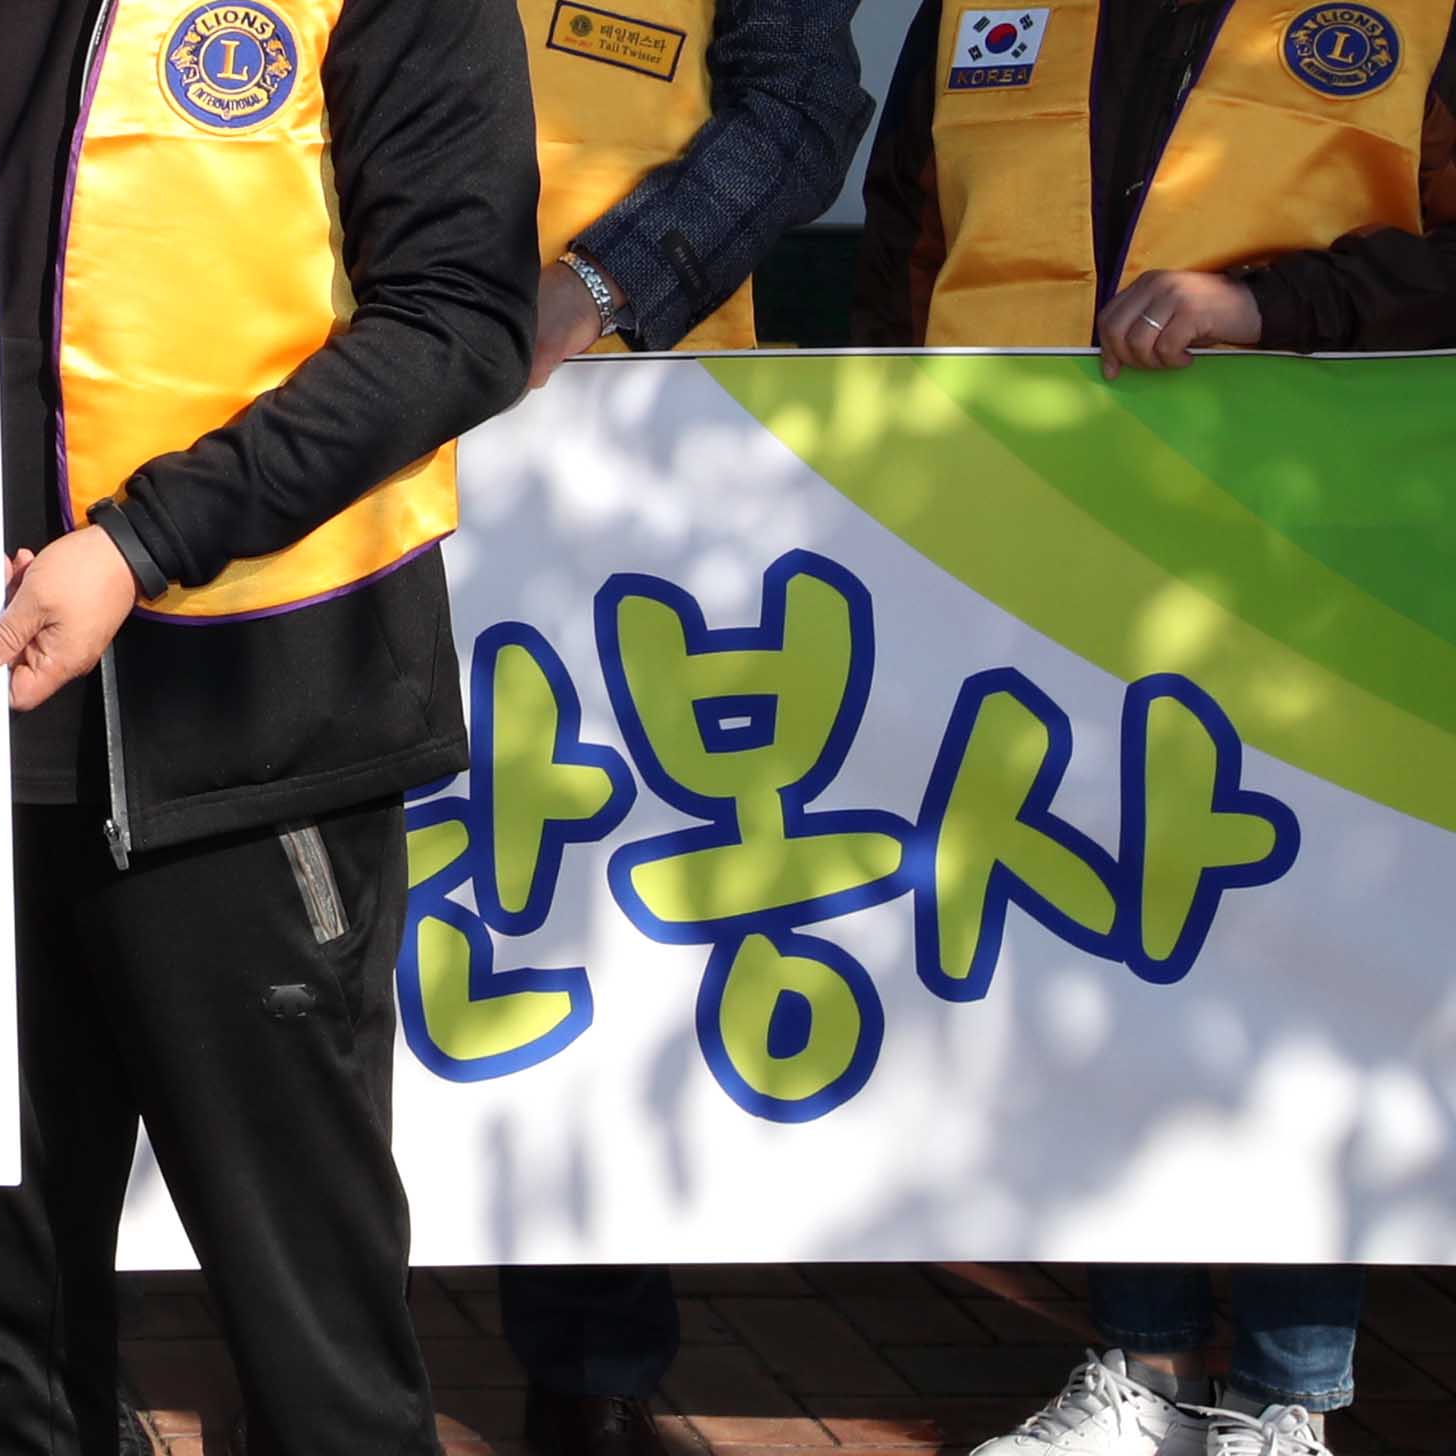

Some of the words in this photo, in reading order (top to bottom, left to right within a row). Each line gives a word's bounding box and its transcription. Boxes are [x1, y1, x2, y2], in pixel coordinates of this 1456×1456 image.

[201, 9, 271, 36] LIONS
[1320, 10, 1381, 35] LIONS
[598, 38, 621, 56] Tail
[1327, 31, 1355, 64] L
[216, 39, 249, 81] L
[956, 67, 1028, 87] KOREA
[193, 87, 264, 112] INTERNATIONAL
